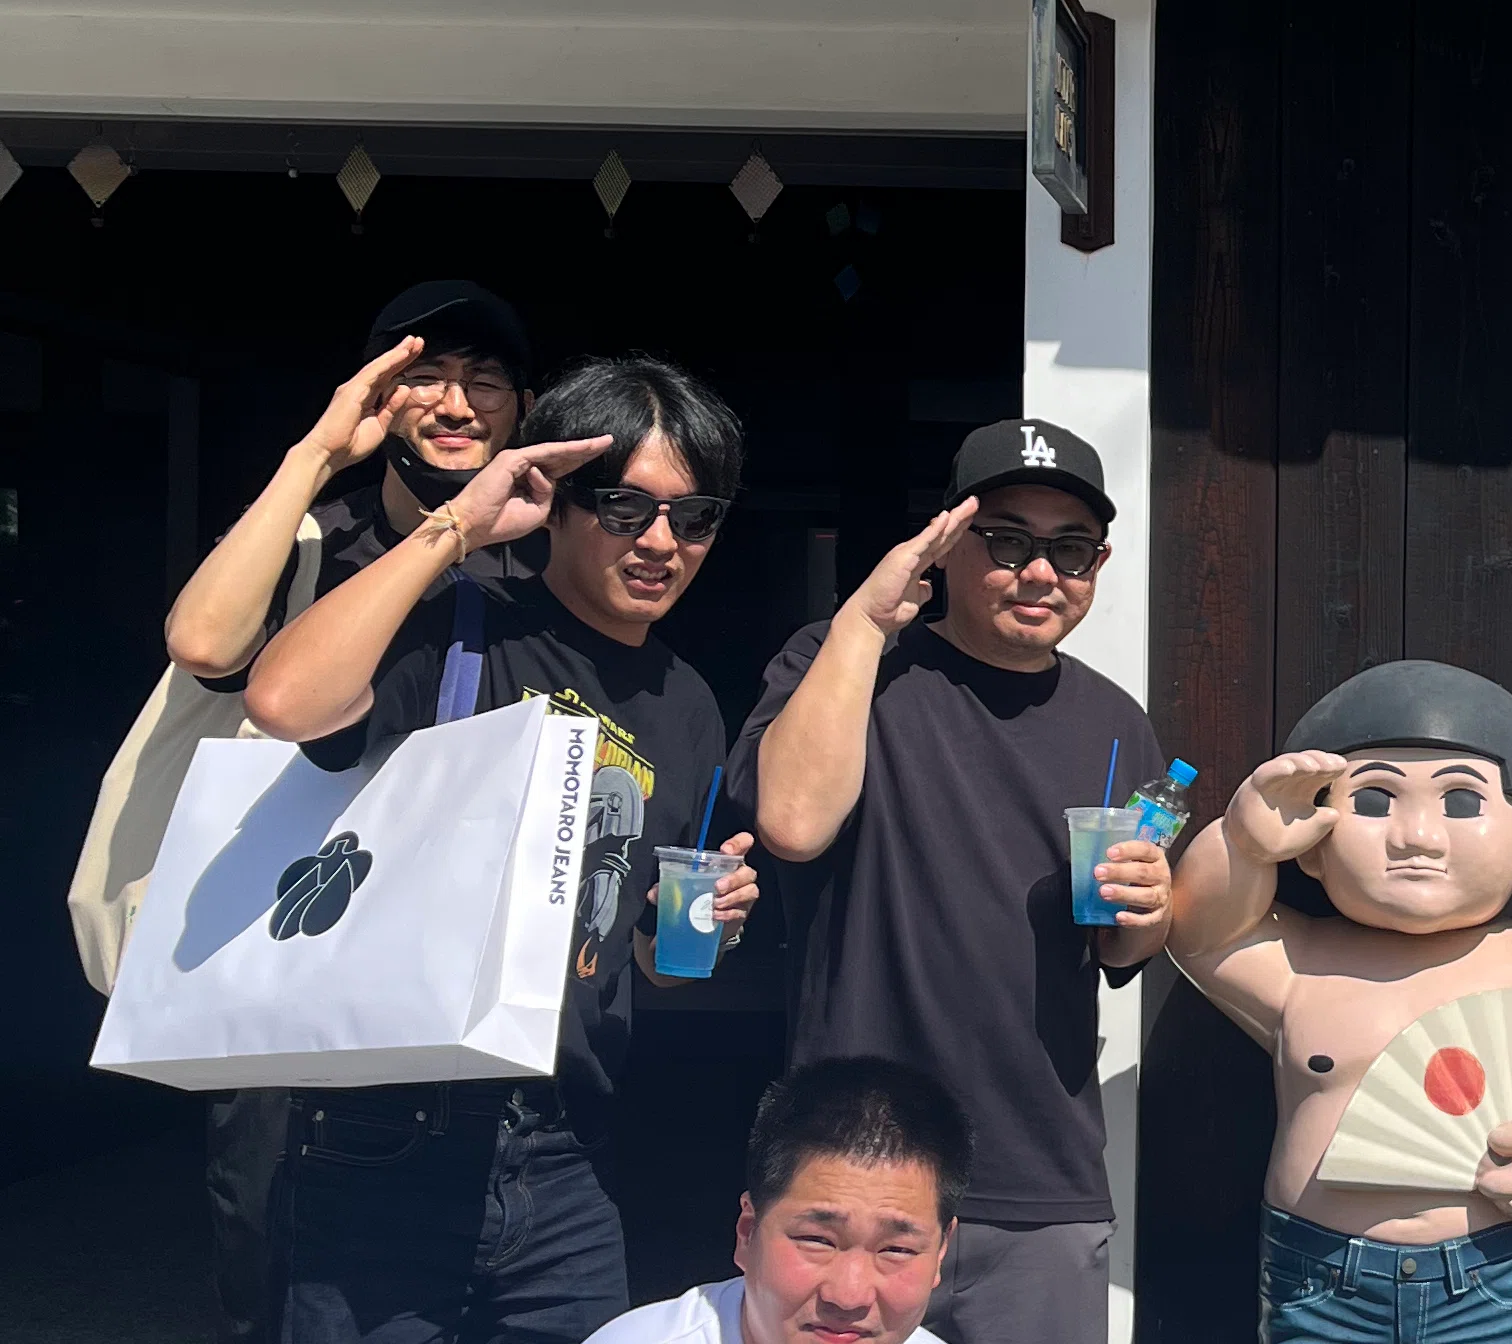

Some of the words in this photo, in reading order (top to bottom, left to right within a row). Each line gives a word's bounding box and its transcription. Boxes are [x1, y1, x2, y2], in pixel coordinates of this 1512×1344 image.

[1020, 426, 1056, 467] LA
[557, 728, 587, 841] MOMOTARO
[548, 844, 570, 905] JEANS
